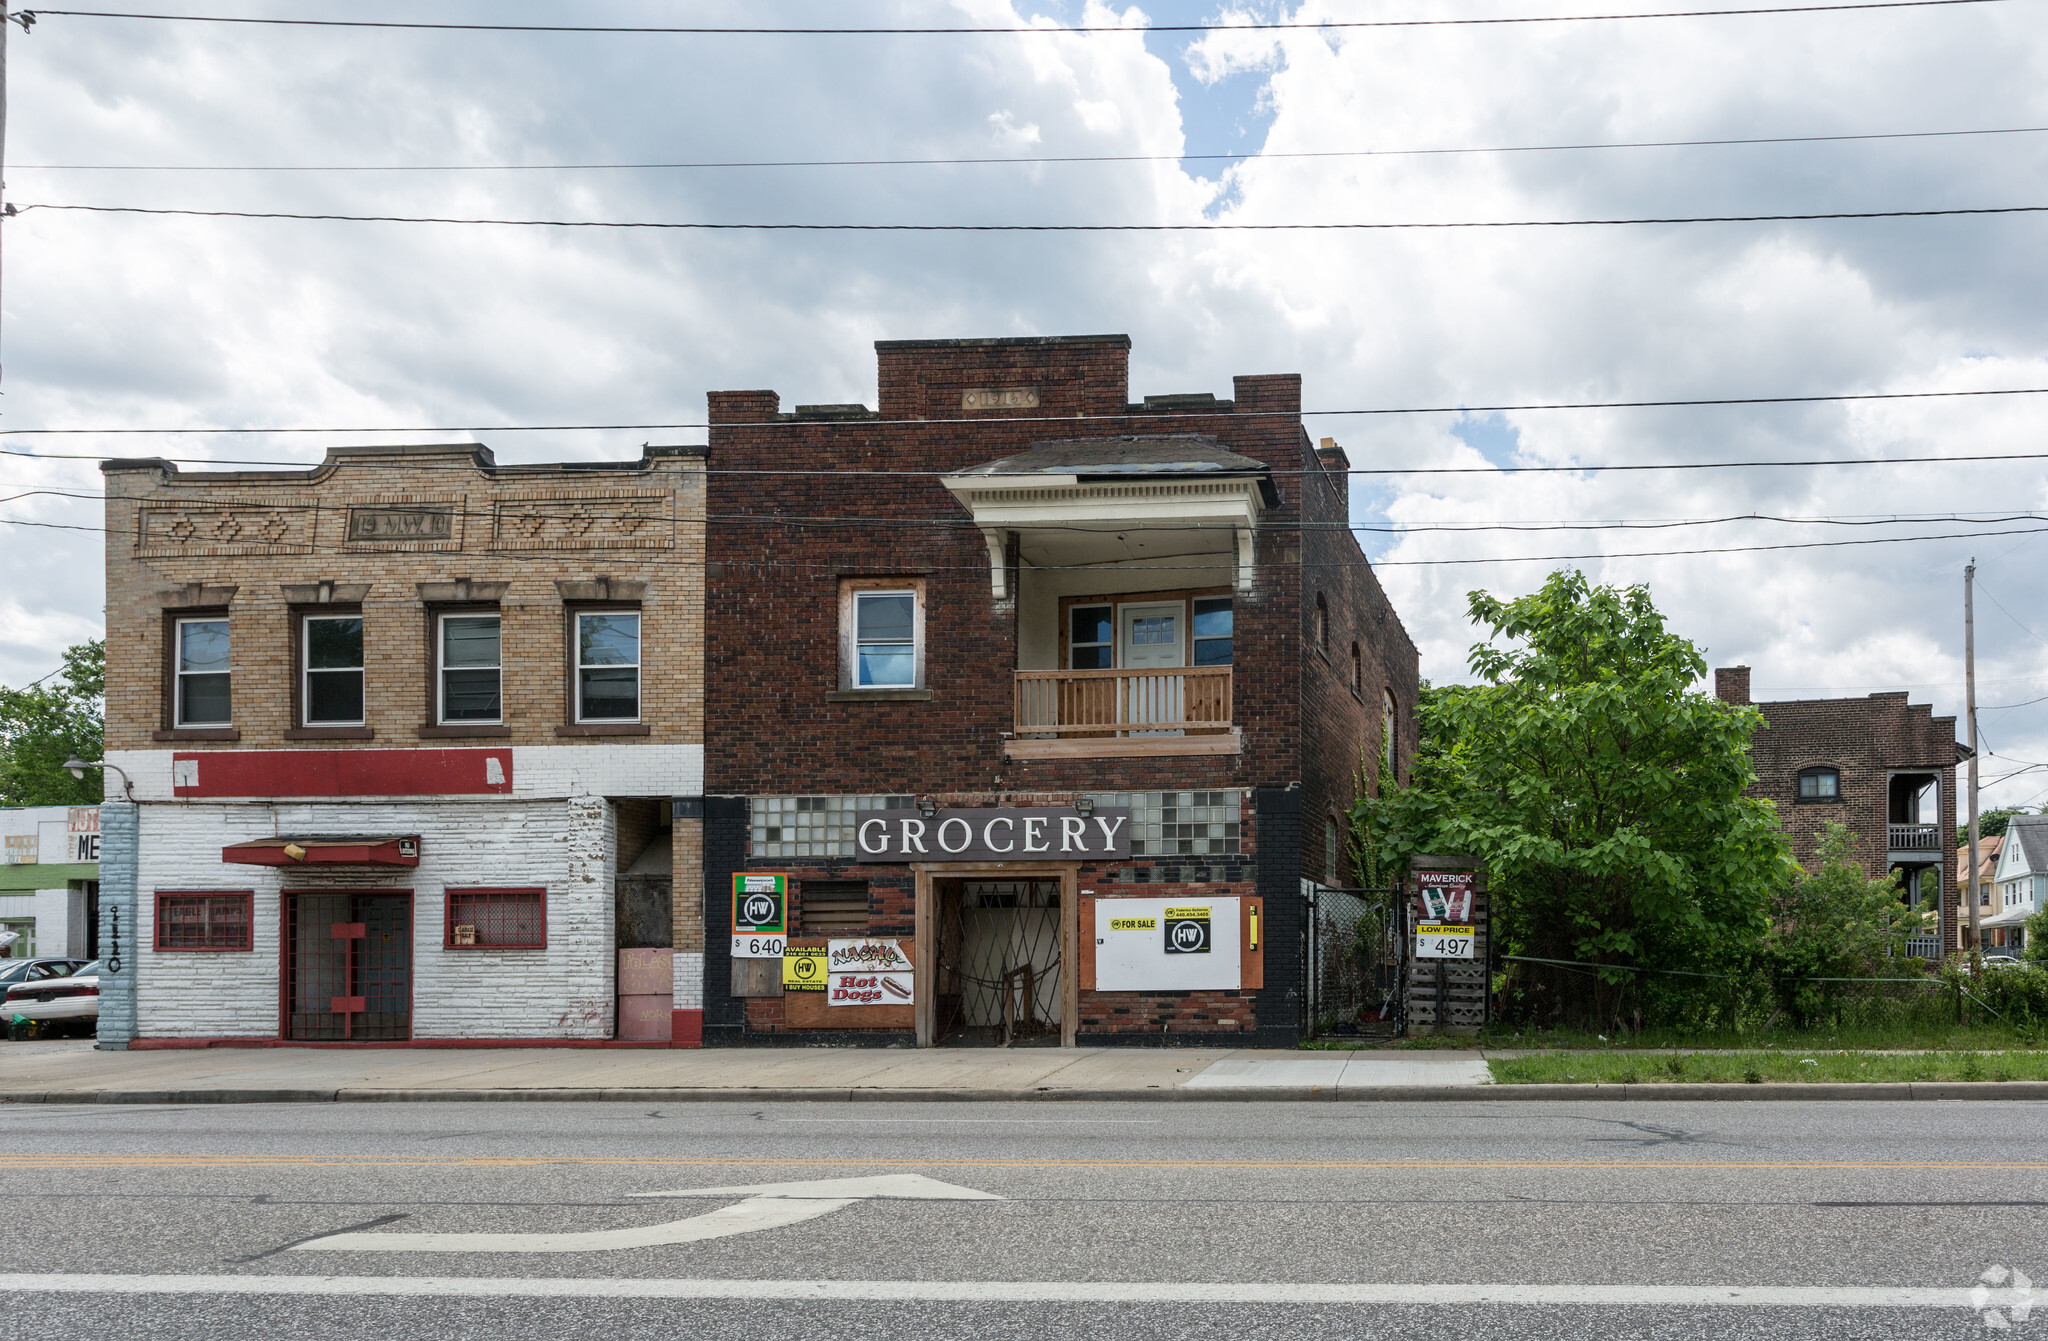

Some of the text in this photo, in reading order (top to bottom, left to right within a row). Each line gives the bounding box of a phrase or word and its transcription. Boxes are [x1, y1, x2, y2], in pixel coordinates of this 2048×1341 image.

[68, 808, 101, 831] AUT
[858, 816, 1127, 854] GROCERY
[1421, 874, 1472, 883] MAVERICK
[749, 901, 769, 916] HW
[1122, 920, 1155, 928] FOR SALE
[735, 939, 741, 948] $
[1177, 928, 1198, 944] HW
[1435, 938, 1469, 956] 4.97
[832, 945, 905, 966] NACHO
[798, 962, 812, 973] HW
[839, 975, 878, 989] Hot
[832, 988, 883, 1003] Dogs
